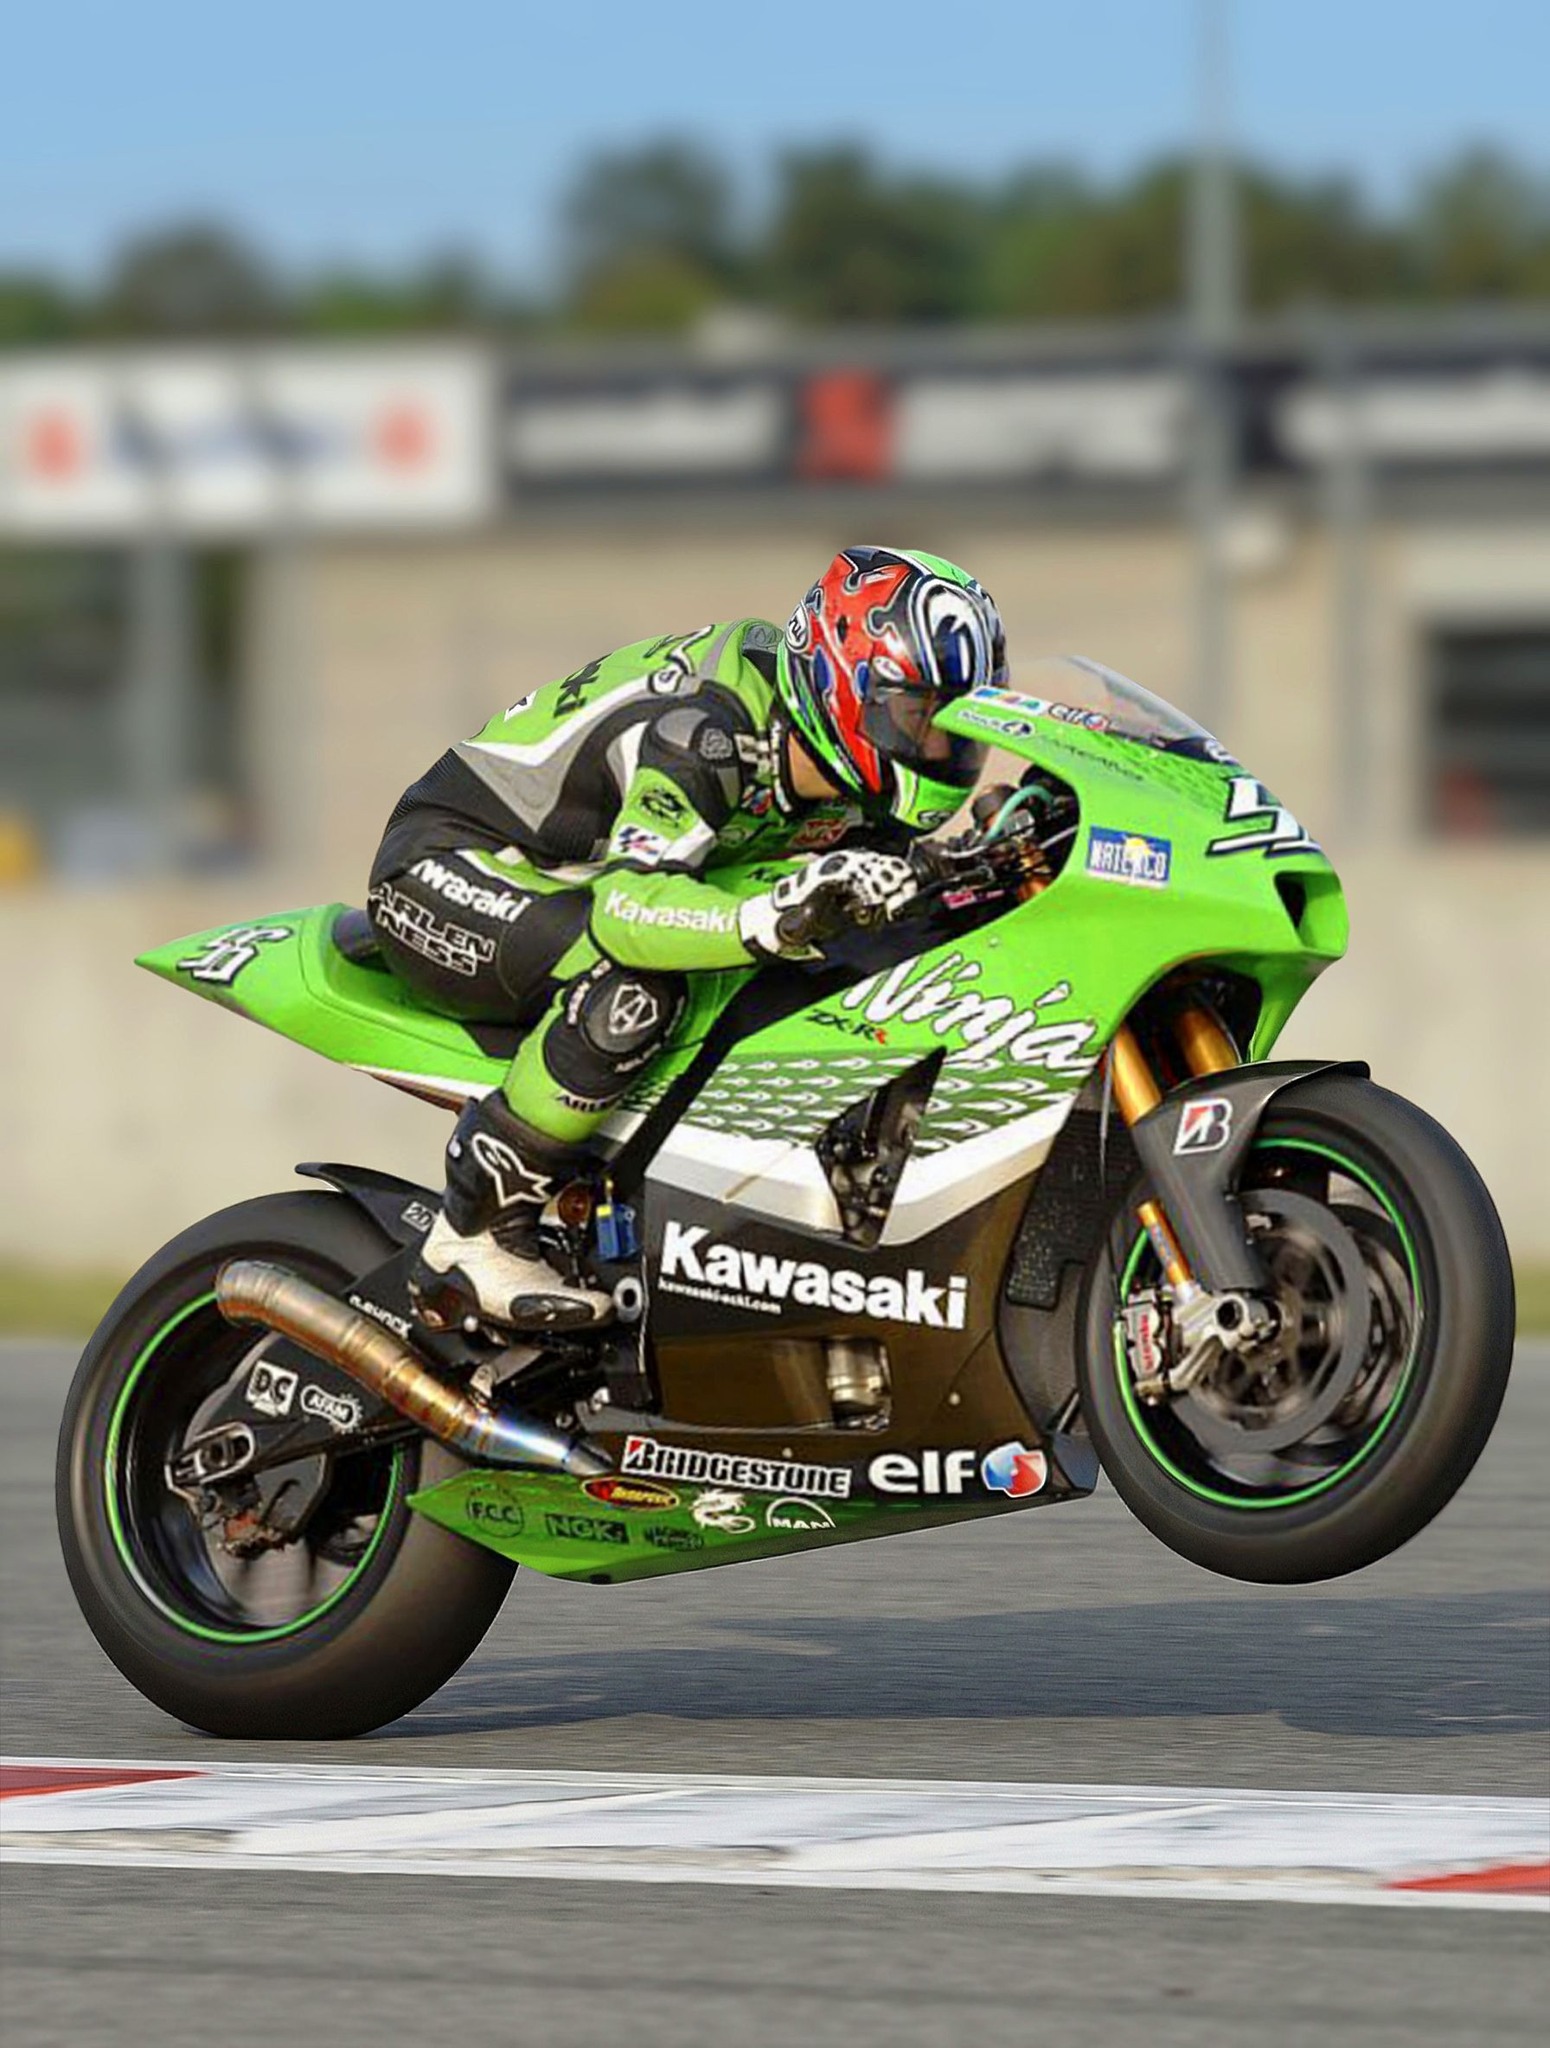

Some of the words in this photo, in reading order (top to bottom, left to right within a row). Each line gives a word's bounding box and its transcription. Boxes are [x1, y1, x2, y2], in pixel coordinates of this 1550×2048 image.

[375, 902, 477, 977] NESS
[604, 889, 738, 933] Kawasaki
[841, 953, 1098, 1070] Ninja
[659, 1221, 968, 1330] Kawasaki
[622, 1436, 852, 1498] BRIDGESTONE
[868, 1450, 976, 1495] elf
